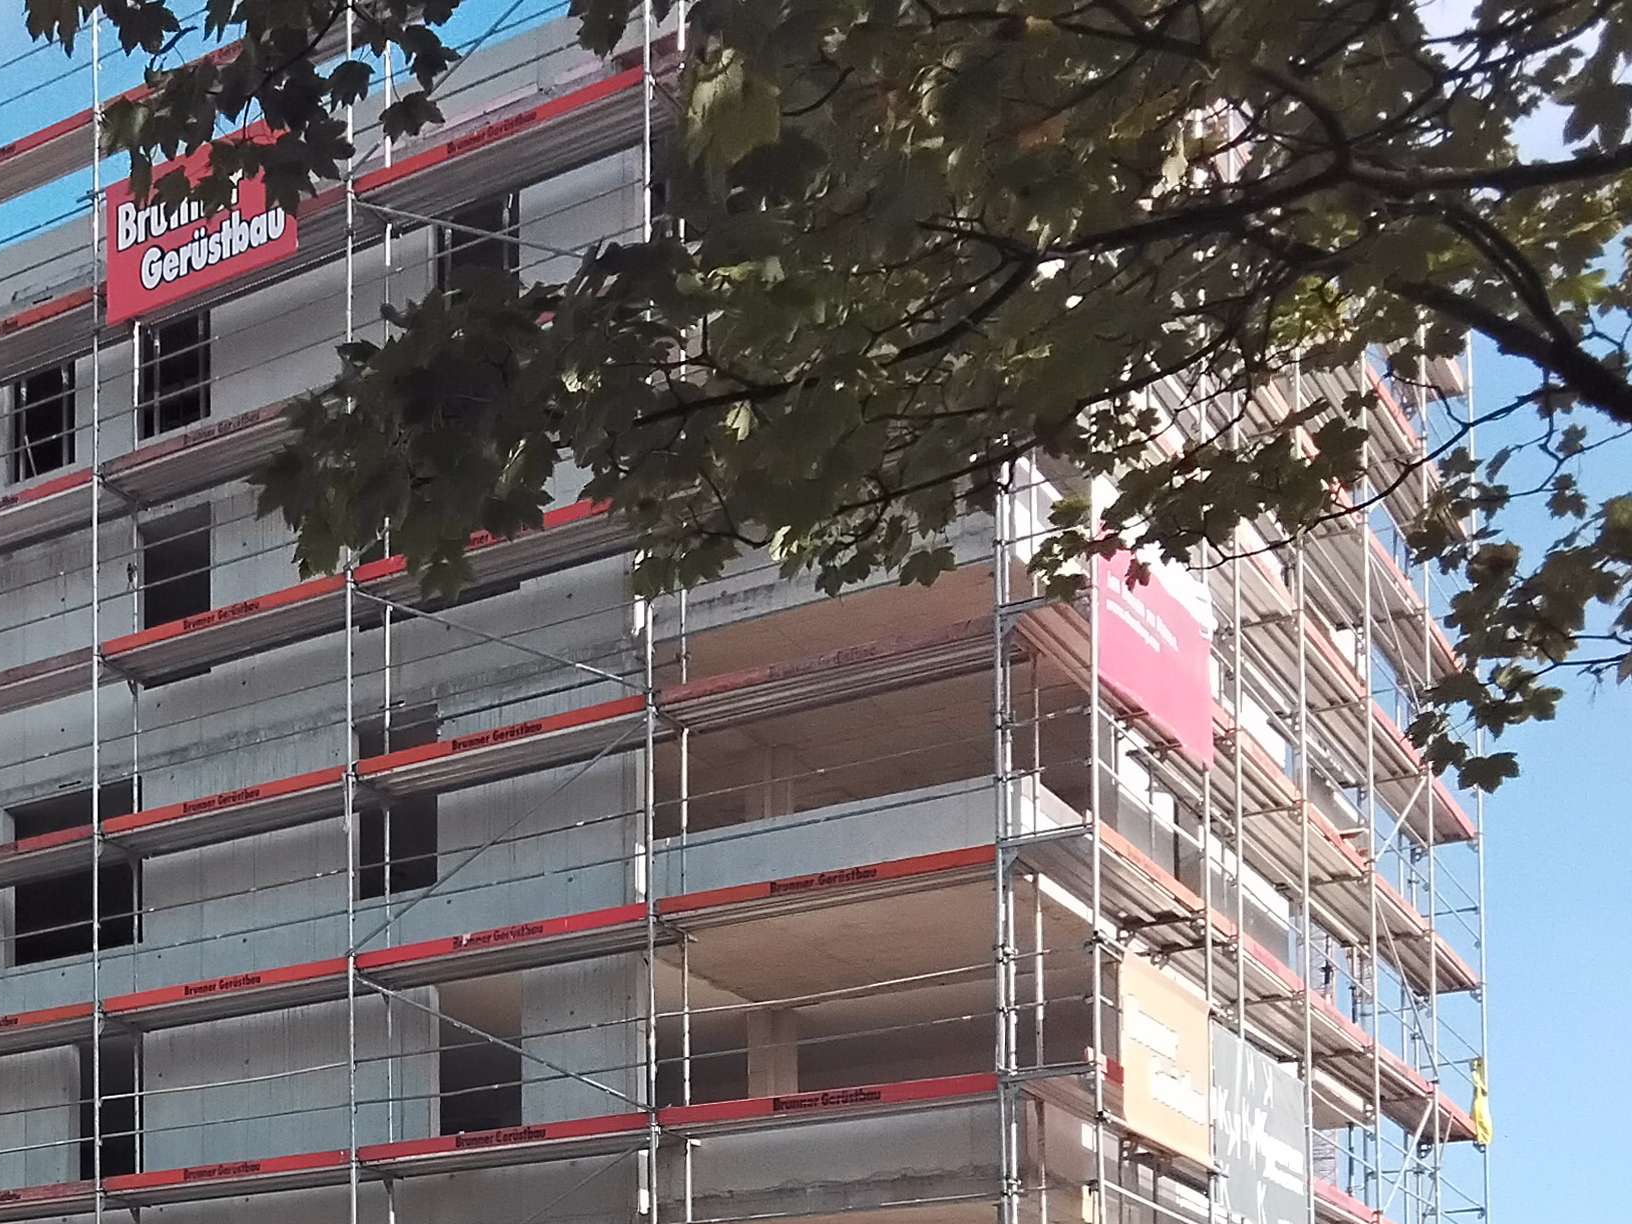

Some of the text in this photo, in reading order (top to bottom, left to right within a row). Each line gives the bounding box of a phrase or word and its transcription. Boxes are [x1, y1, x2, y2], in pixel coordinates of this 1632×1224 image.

[141, 206, 286, 290] Gerüstbau
[451, 722, 543, 751] Brunner Gerüstbau
[770, 867, 877, 894] Brunner Gerüstbau
[184, 974, 262, 996] Brunner Gerüstbau
[773, 1089, 882, 1111] Brunner Gerüstbau
[455, 1127, 546, 1148] Brunner Gerüstbau
[183, 1161, 261, 1180] Brunner Gerüstbau
